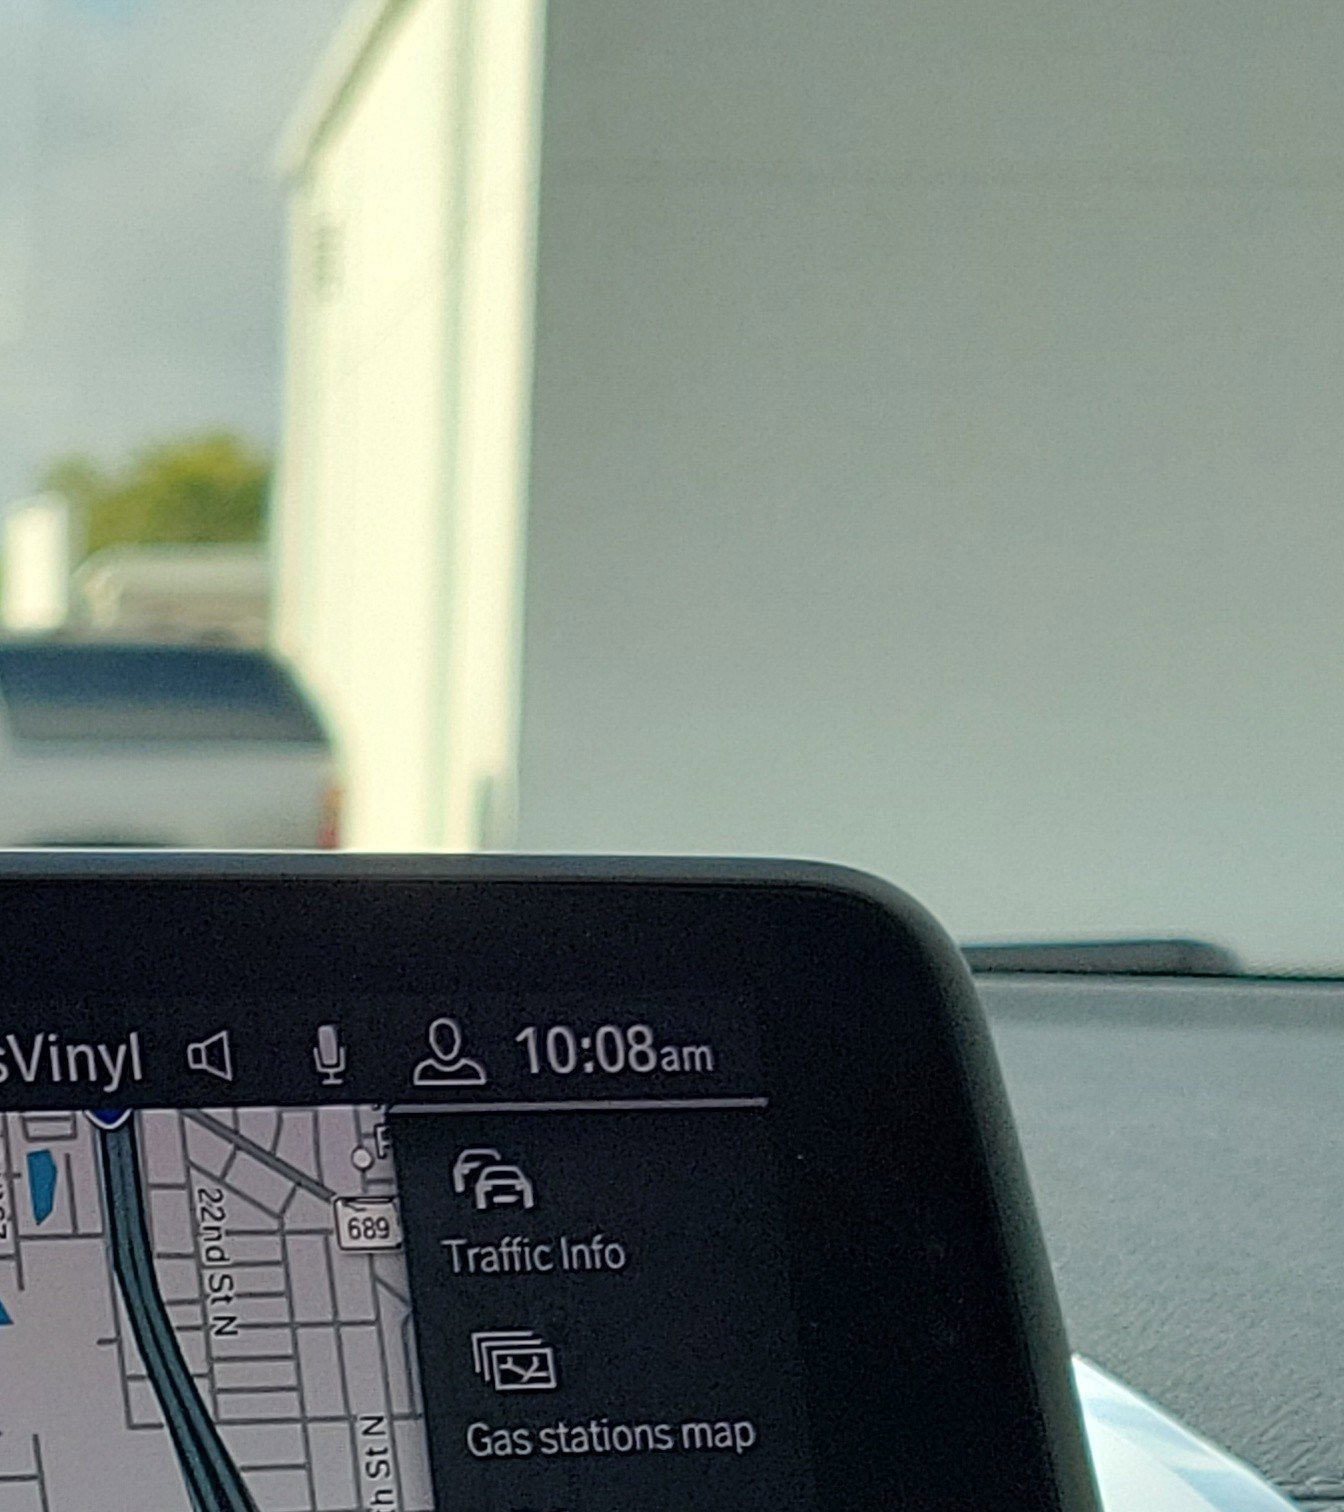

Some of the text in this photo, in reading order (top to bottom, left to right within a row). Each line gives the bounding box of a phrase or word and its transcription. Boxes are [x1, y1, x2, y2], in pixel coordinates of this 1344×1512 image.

[515, 1025, 713, 1074] 10:08am
[347, 1217, 390, 1240] 689
[197, 1186, 238, 1336] 22nd St N
[443, 1236, 626, 1272] Traffic Info
[360, 1415, 386, 1437] N
[467, 1420, 755, 1456] Gas stations map
[365, 1446, 391, 1480] St
